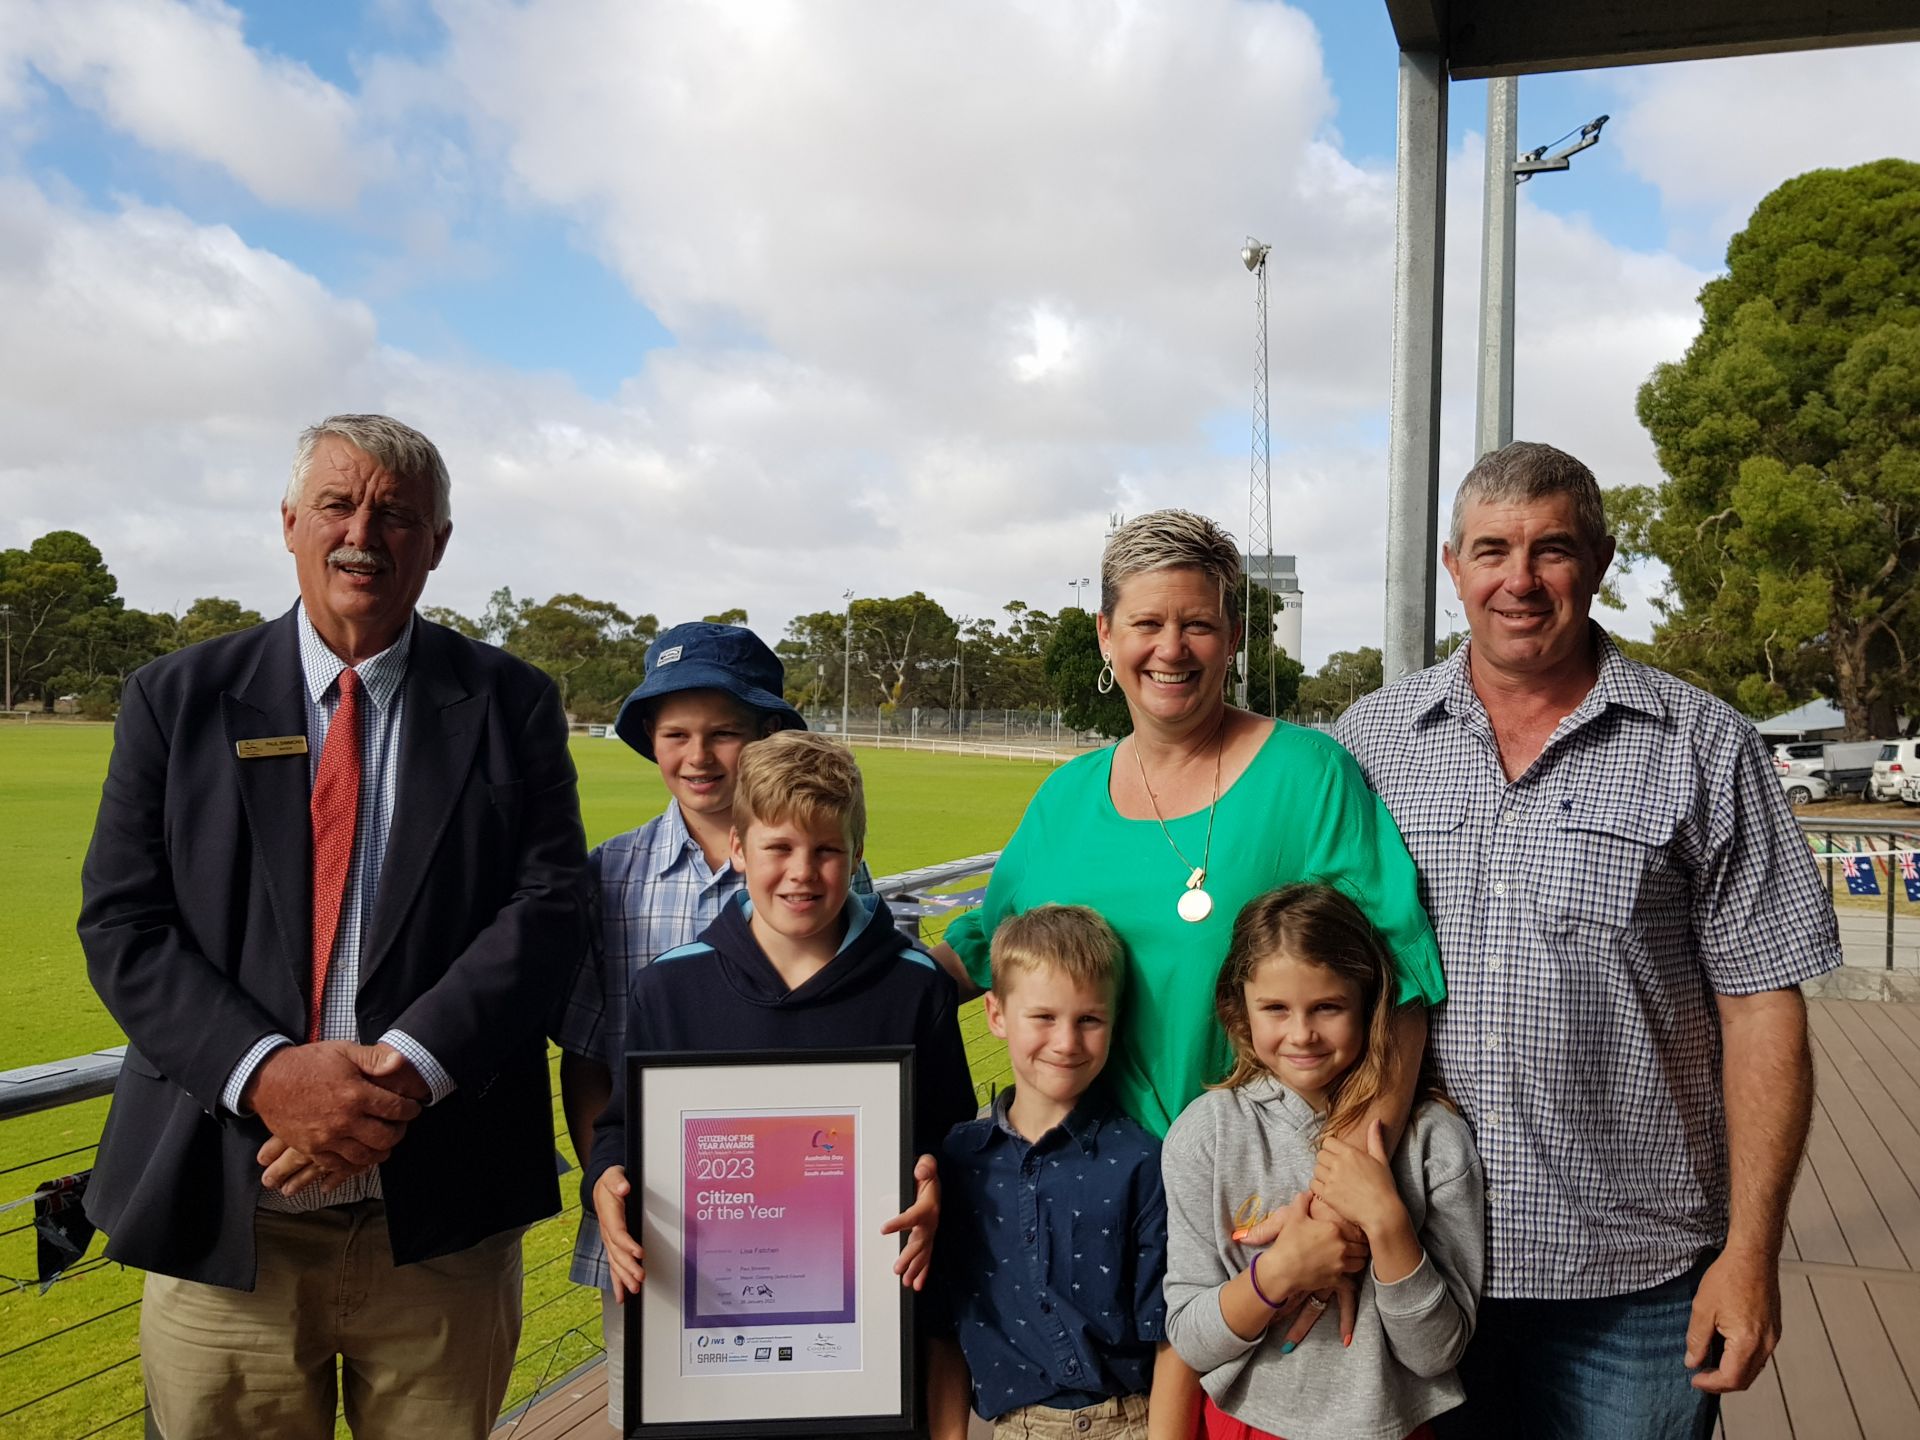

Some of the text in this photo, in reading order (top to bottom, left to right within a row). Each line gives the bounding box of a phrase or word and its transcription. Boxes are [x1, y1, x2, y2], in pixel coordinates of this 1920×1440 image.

[719, 1141, 755, 1149] AWARDS
[831, 1154, 844, 1162] Day
[697, 1158, 754, 1179] 2023
[697, 1190, 754, 1205] Citizen
[696, 1205, 786, 1221] of the Year
[697, 1353, 728, 1364] SARAH
